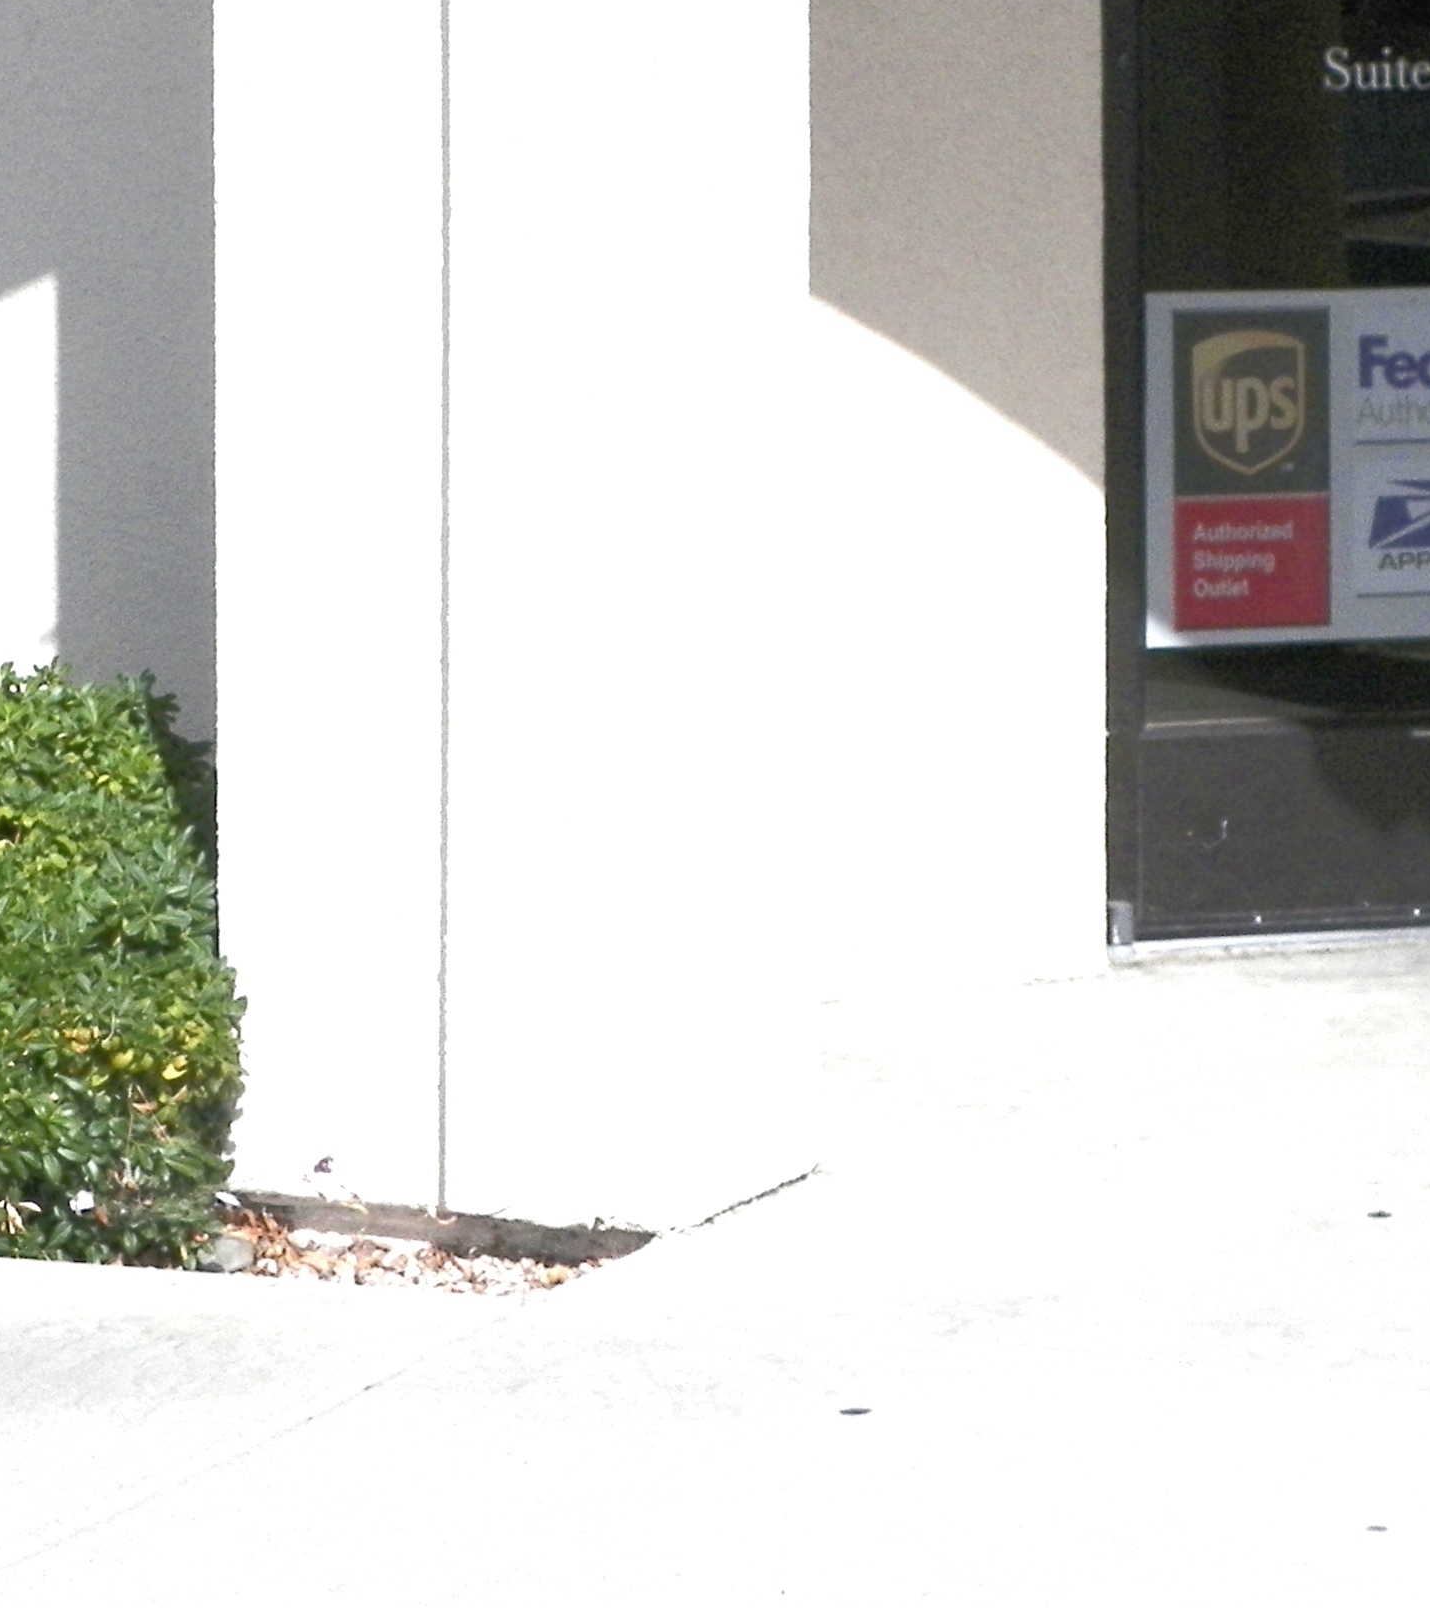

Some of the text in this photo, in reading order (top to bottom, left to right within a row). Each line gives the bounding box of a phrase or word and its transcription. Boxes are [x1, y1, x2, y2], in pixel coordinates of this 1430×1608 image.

[1201, 376, 1296, 453] ups
[1193, 520, 1294, 542] Authorized
[1193, 550, 1275, 575] Shipping
[1193, 579, 1249, 598] Outlet
